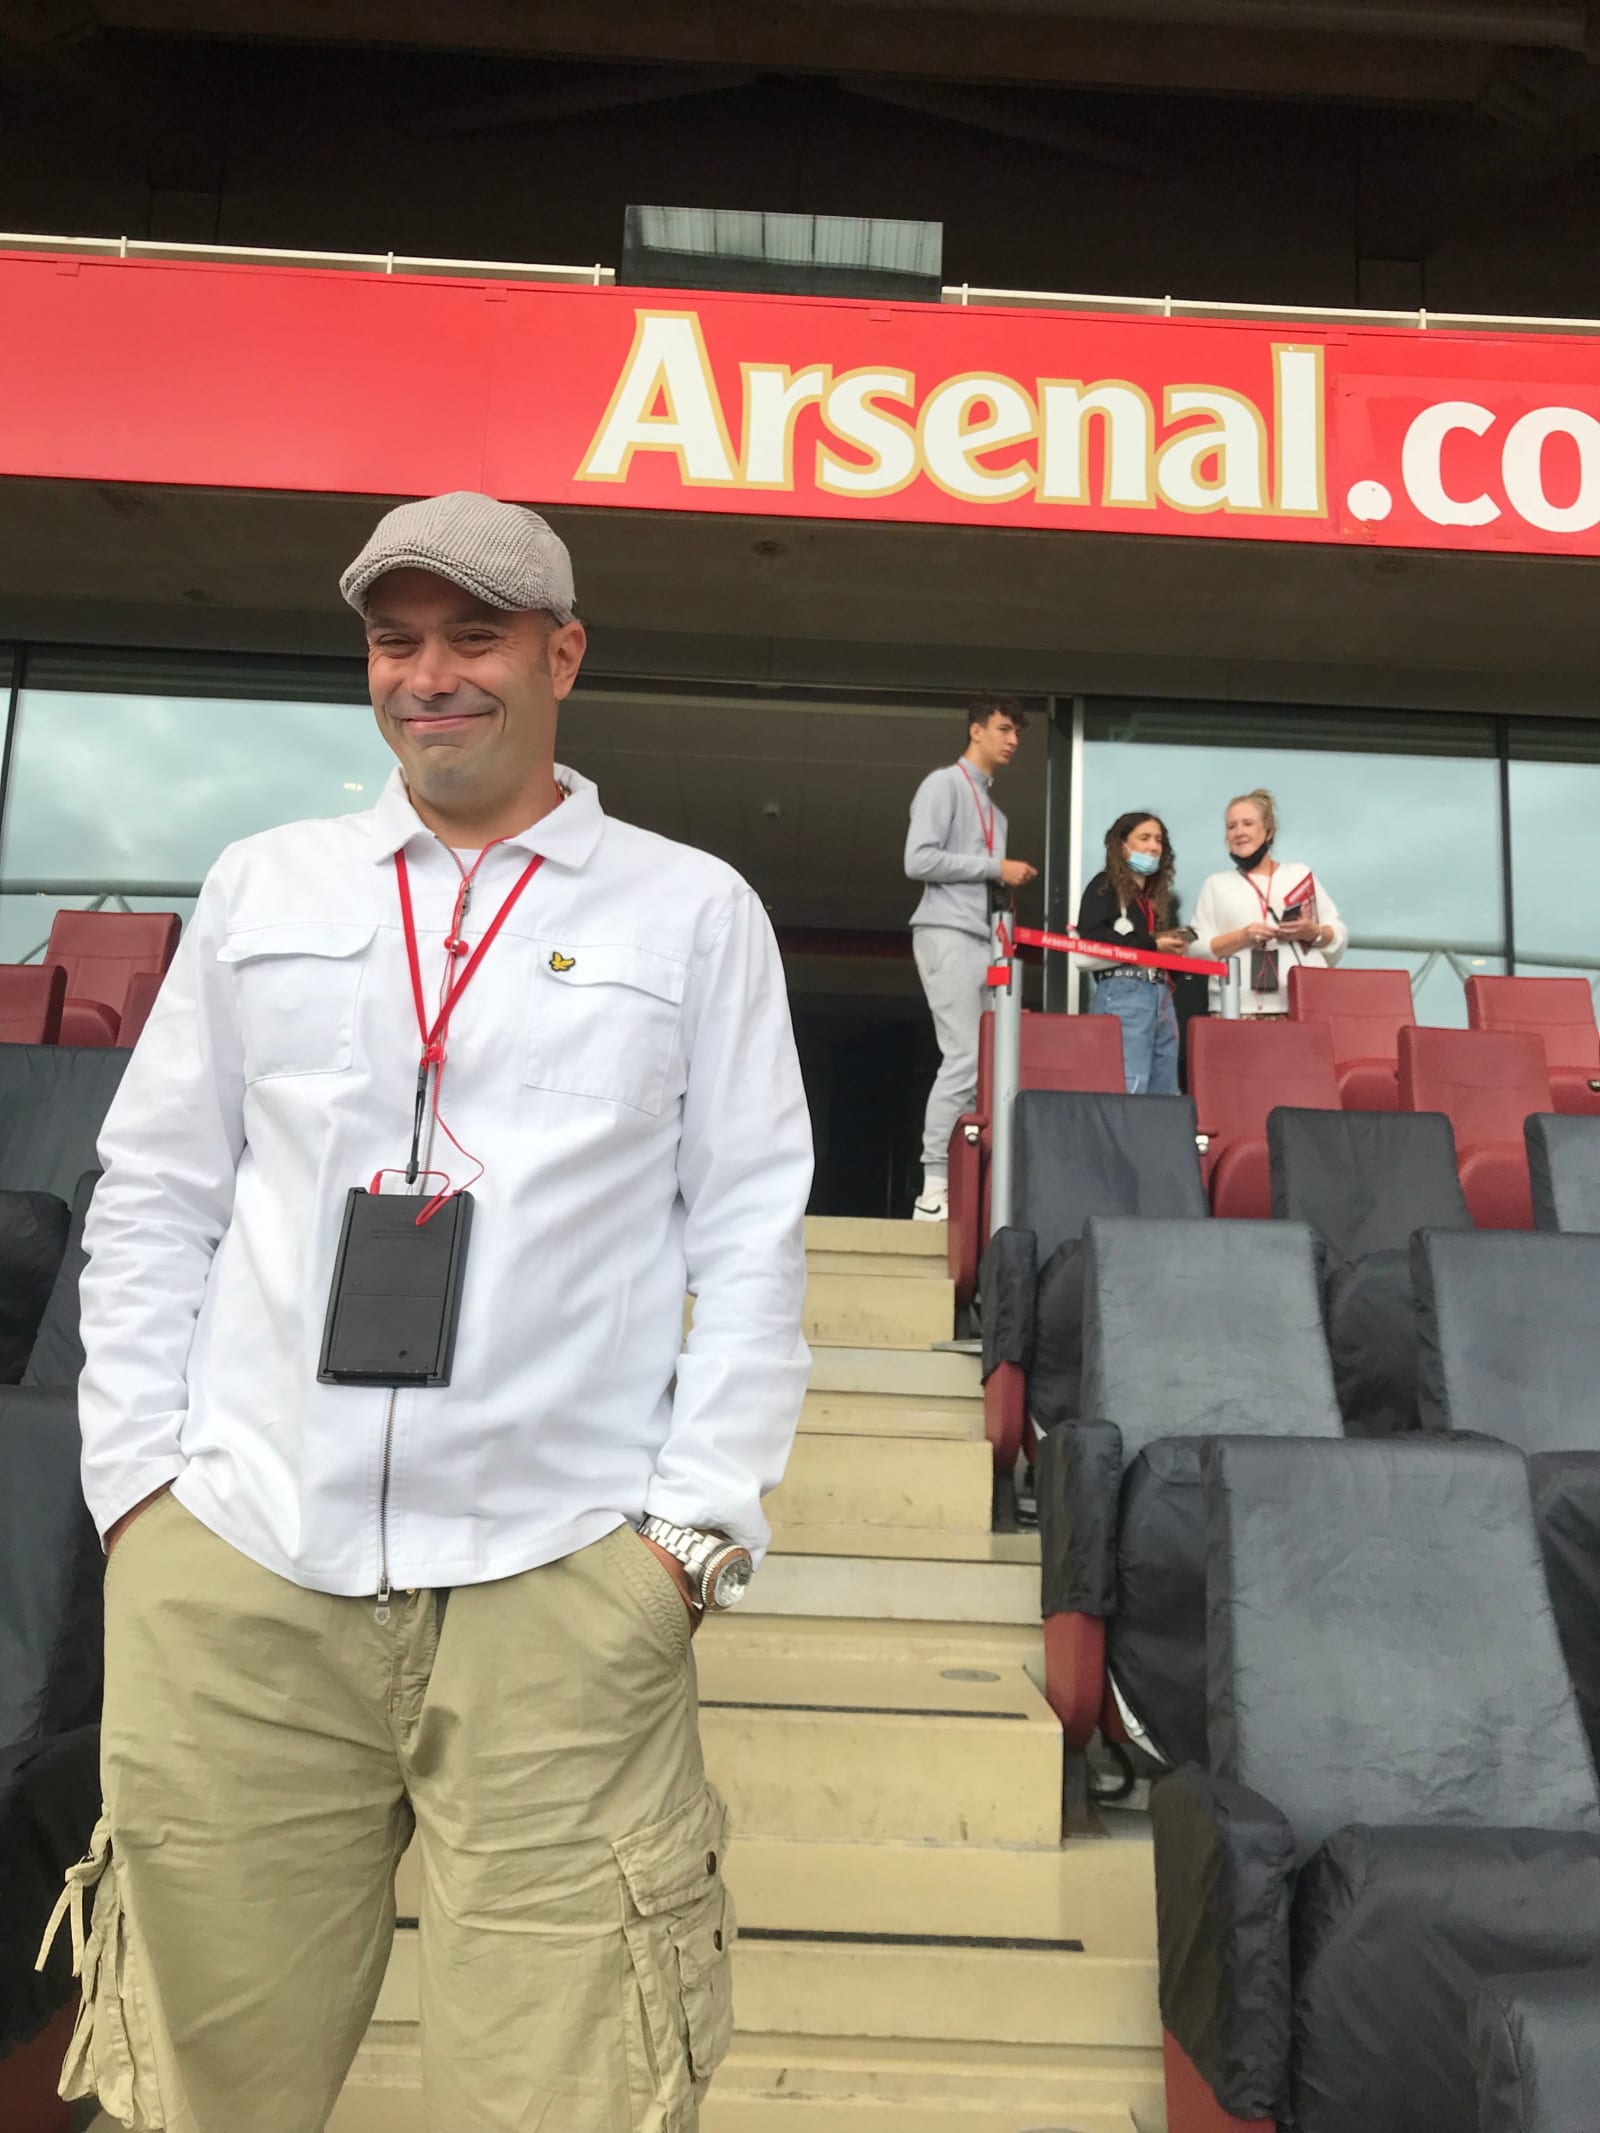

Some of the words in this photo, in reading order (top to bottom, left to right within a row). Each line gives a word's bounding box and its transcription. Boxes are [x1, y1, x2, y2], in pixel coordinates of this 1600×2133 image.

[1042, 935, 1076, 949] Arsenal
[1078, 941, 1113, 957] Stadium
[1115, 946, 1138, 961] Tours
